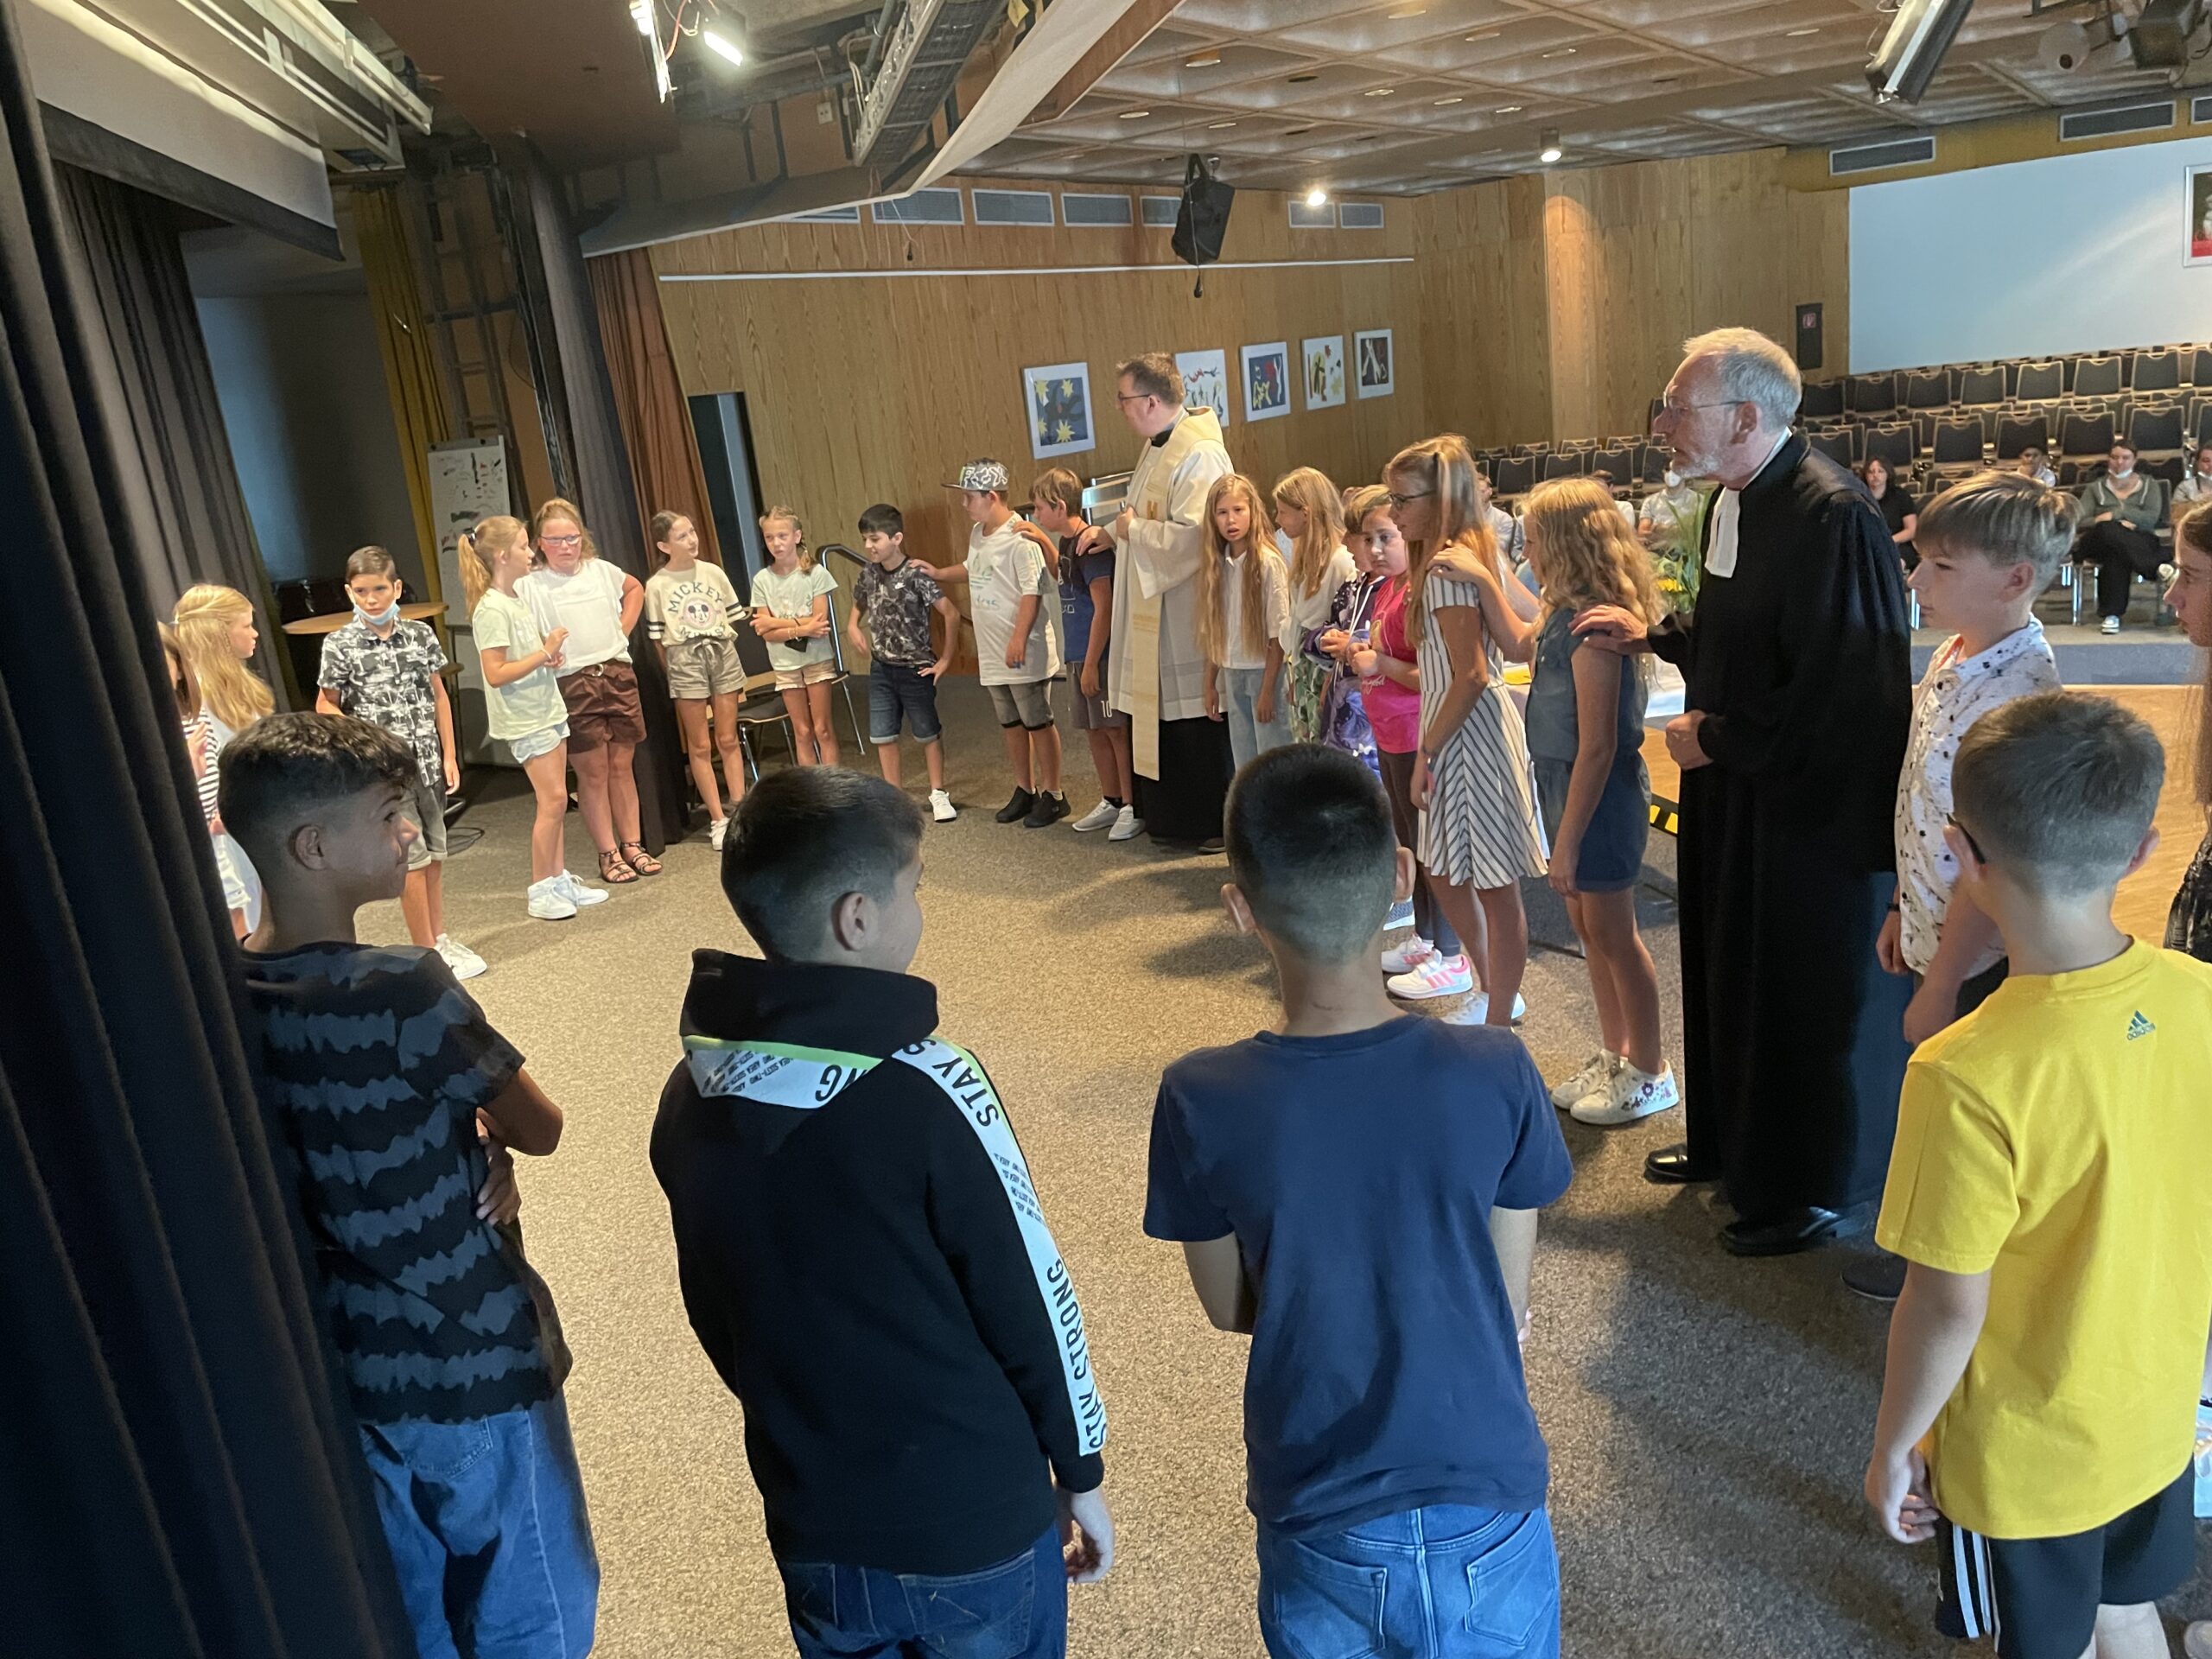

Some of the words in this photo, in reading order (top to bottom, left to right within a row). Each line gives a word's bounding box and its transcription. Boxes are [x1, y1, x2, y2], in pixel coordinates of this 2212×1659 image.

[668, 582, 722, 613] MICKEY
[931, 1057, 999, 1127] STAY
[1047, 1258, 1090, 1380] STRONG
[1078, 1384, 1107, 1449] STAY
